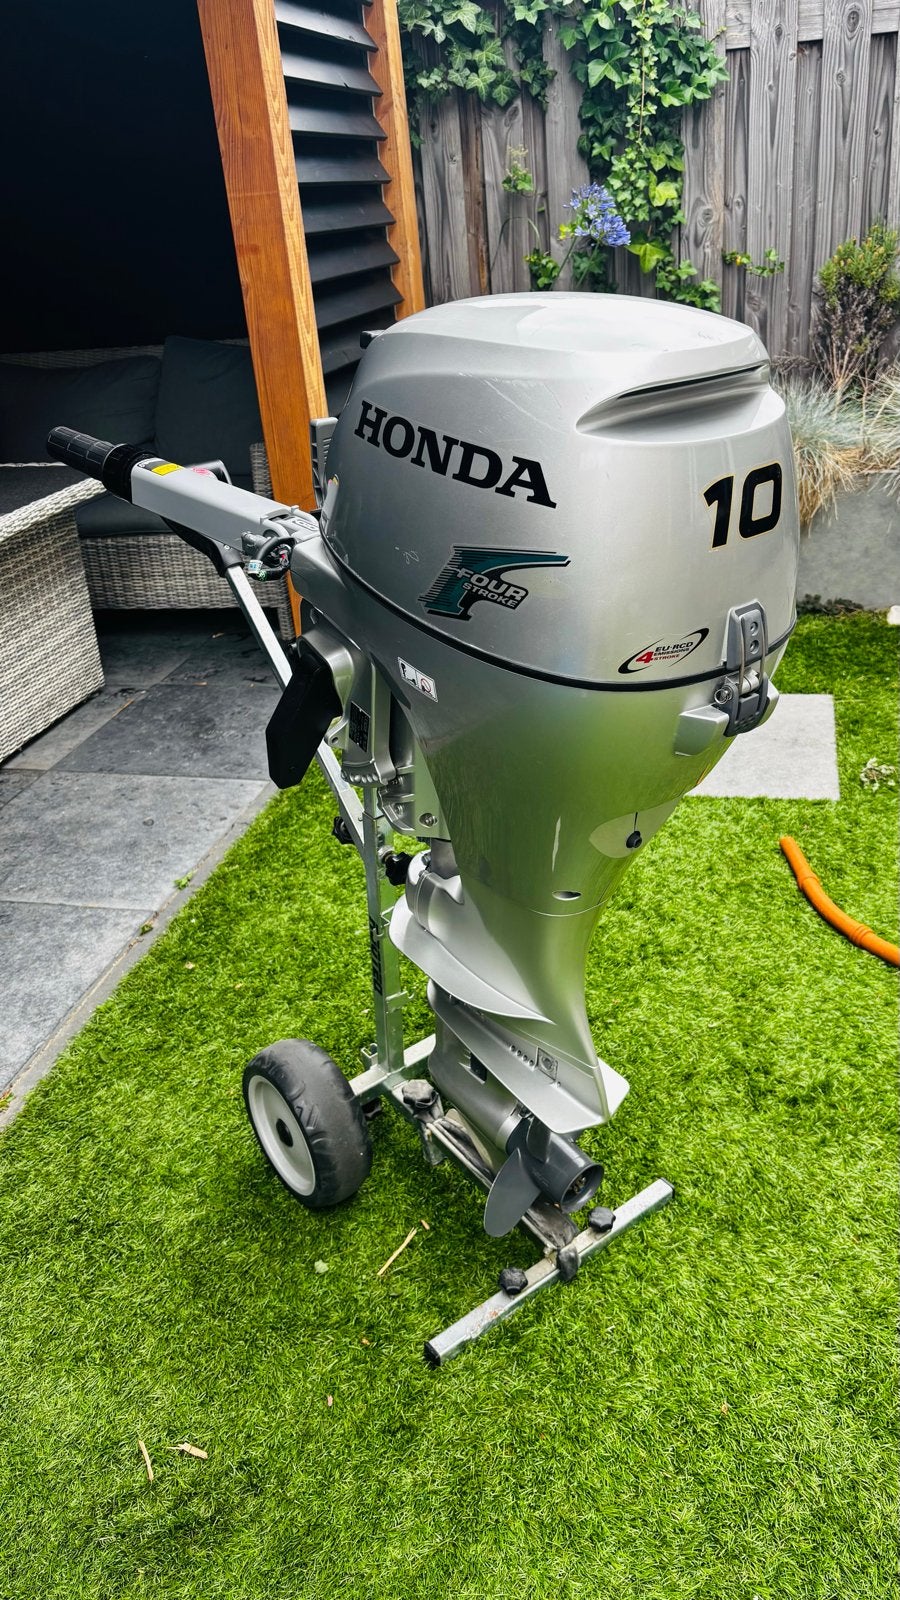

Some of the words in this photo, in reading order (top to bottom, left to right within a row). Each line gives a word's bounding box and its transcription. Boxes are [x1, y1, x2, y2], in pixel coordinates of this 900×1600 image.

[354, 400, 557, 509] HONDA
[703, 462, 782, 549] 10
[456, 567, 527, 600] FOUR
[462, 582, 518, 608] STROKE
[635, 651, 655, 664] 4
[653, 653, 681, 661] STROKE
